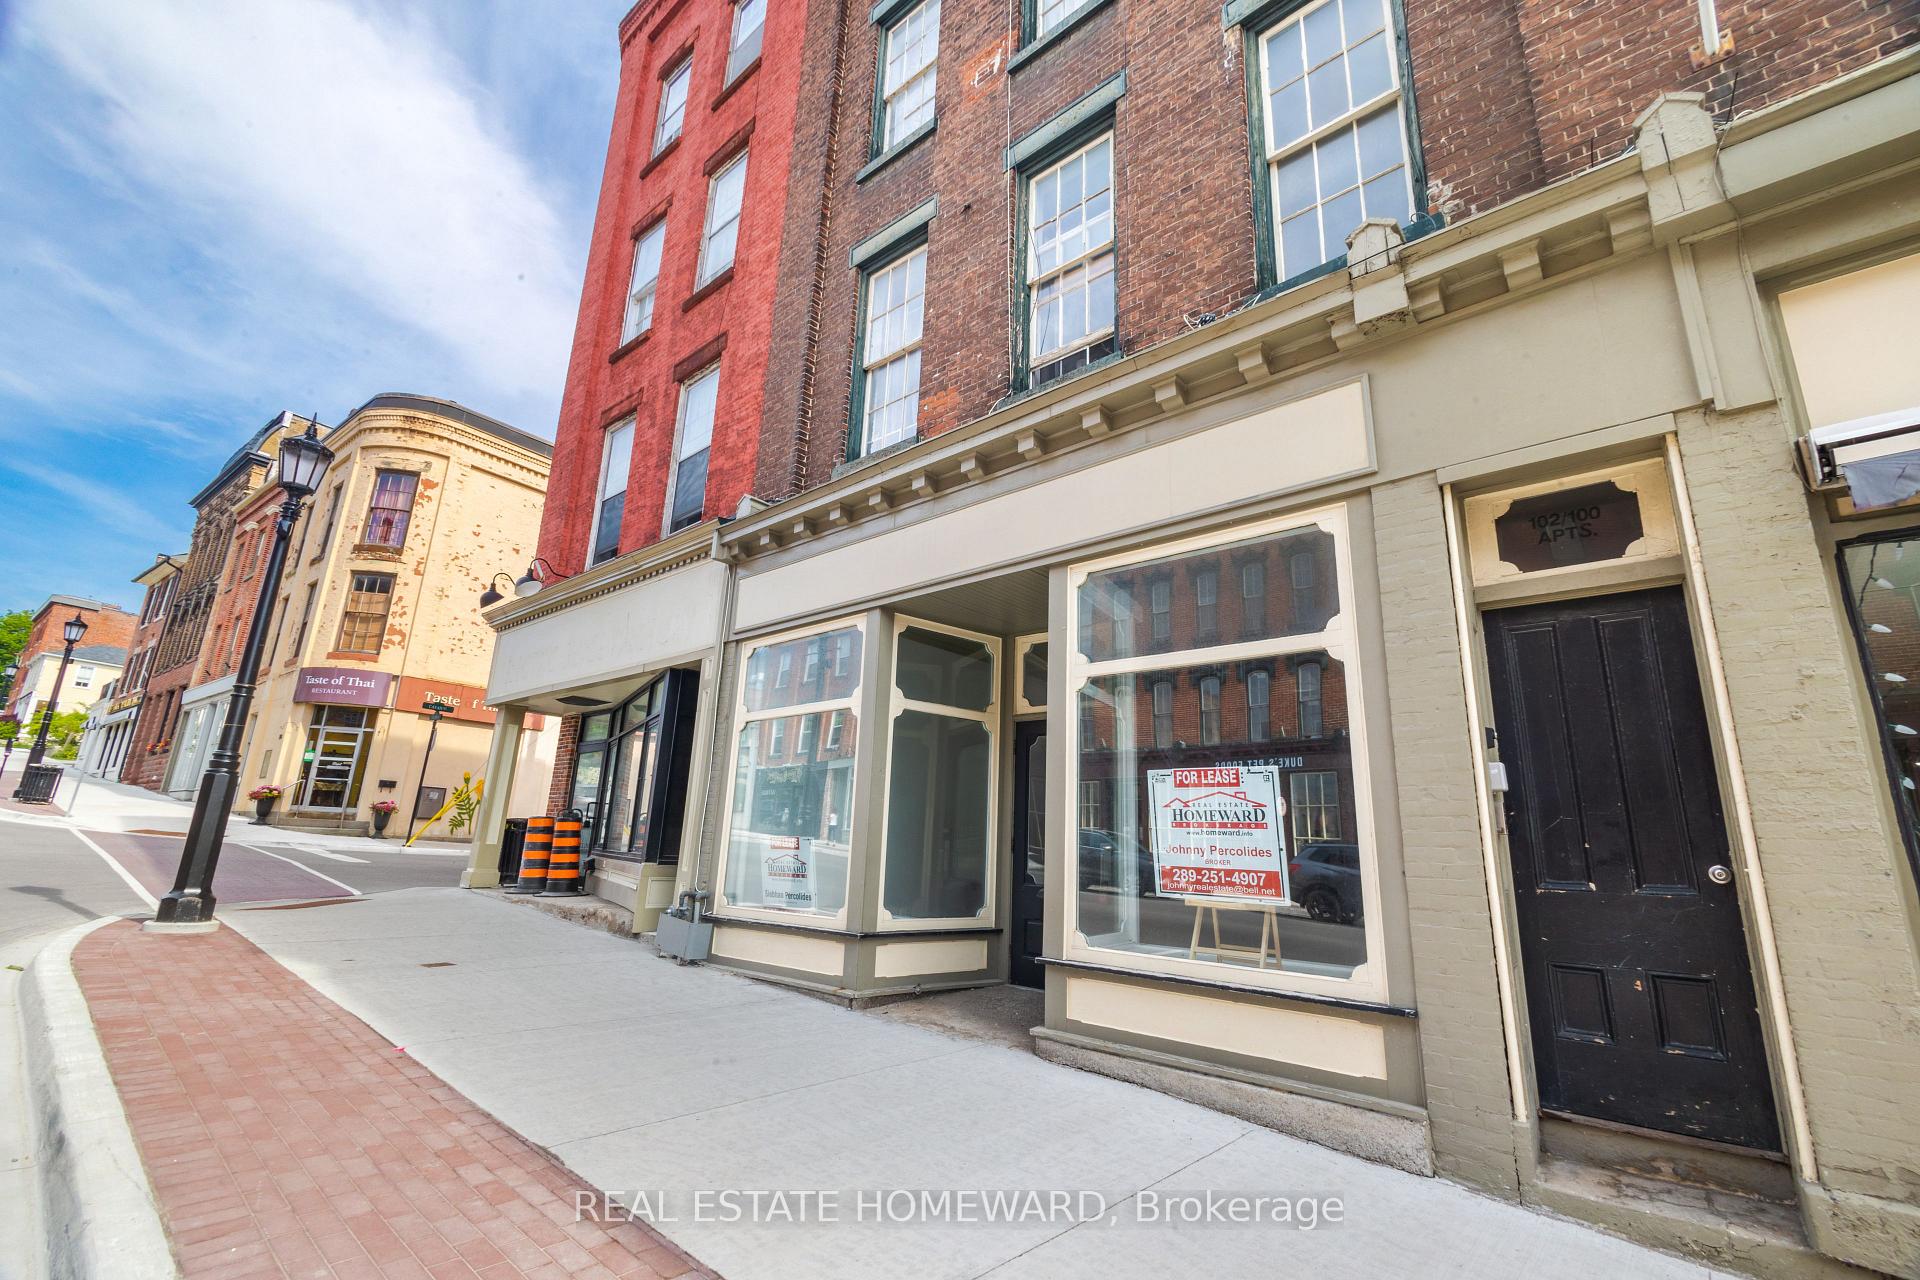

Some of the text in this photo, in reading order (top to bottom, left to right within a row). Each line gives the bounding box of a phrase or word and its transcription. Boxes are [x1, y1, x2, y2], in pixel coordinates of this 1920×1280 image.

[1528, 506, 1601, 530] 102/100
[1538, 523, 1598, 545] APTS.
[305, 675, 376, 688] Taste of Thai
[311, 688, 358, 696] RESTAURANT
[425, 691, 461, 706] Taste
[1175, 770, 1198, 785] FOR
[1201, 768, 1237, 785] LEASE
[1172, 808, 1266, 822] HOMEWARD
[1165, 844, 1273, 858] Johnny Percolides
[1172, 868, 1266, 887] 289-251-4907
[1167, 881, 1276, 896] johnnyrealestate@bell.net
